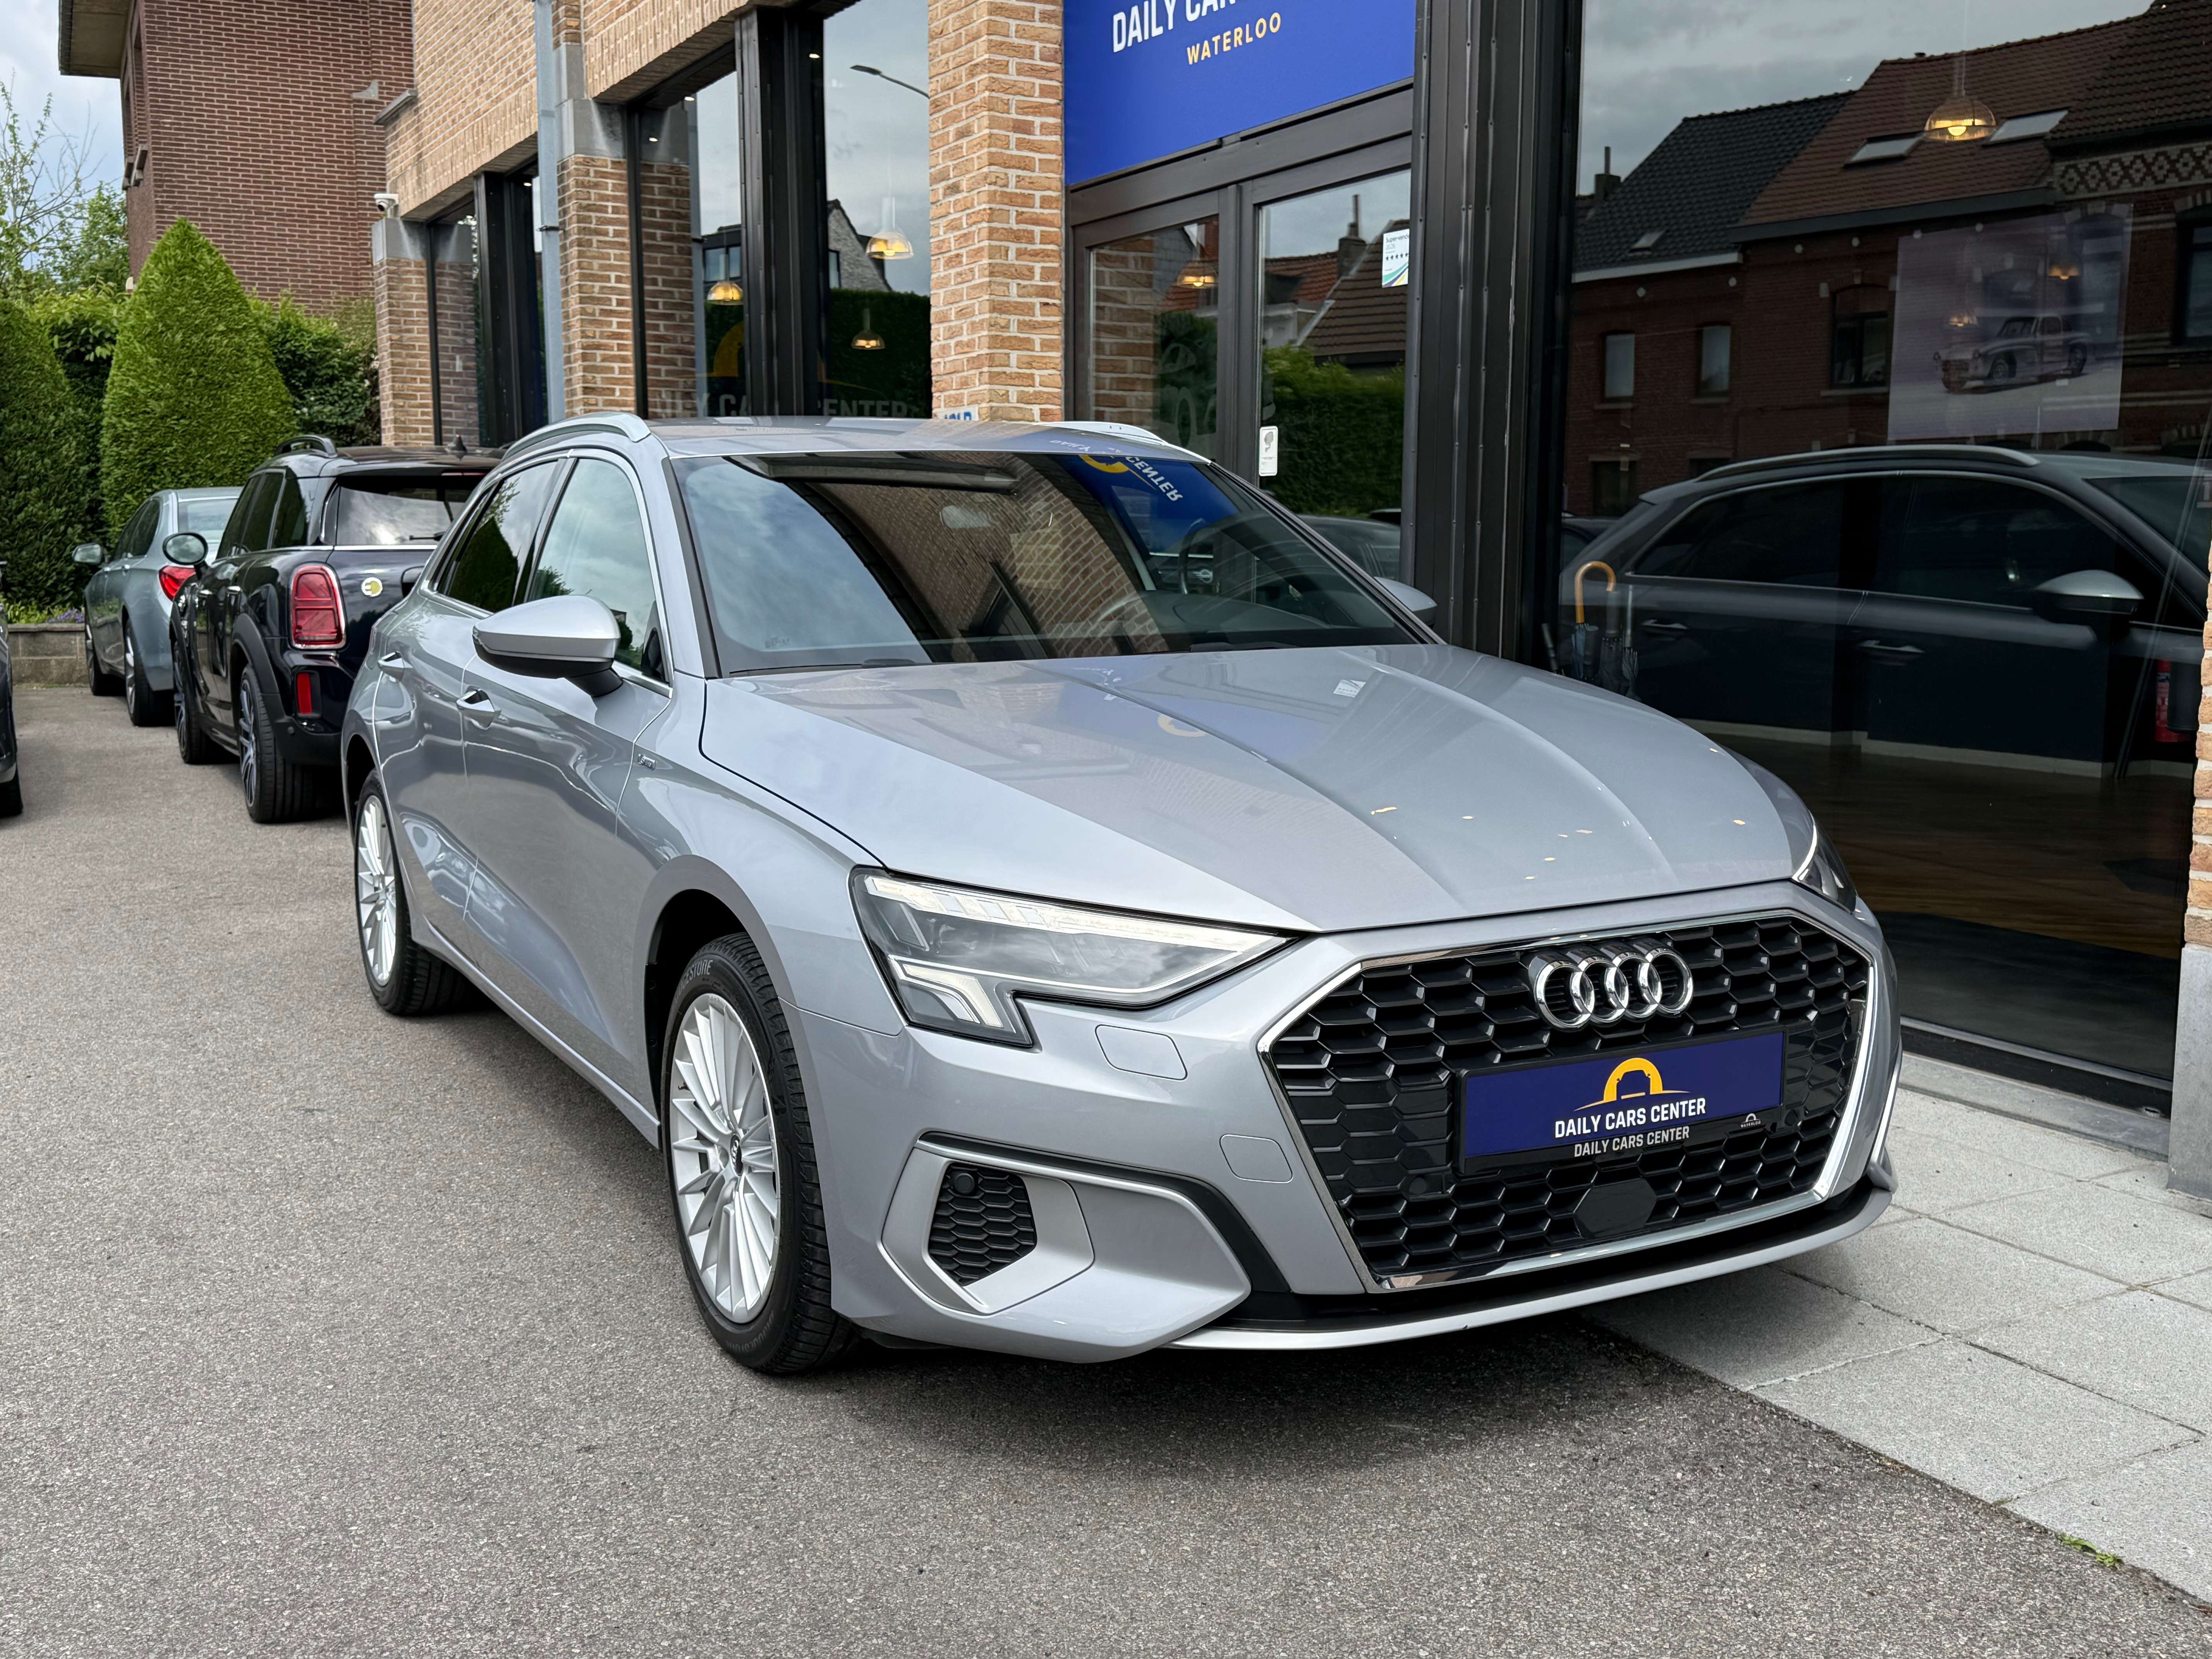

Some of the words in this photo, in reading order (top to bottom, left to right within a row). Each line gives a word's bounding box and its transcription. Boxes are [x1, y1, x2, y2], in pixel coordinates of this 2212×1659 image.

[1113, 0, 1176, 53] DAILY
[1187, 12, 1281, 65] WATERLOO
[817, 398, 907, 417] ENTER
[1555, 1114, 1601, 1139] DAILY
[1605, 1107, 1647, 1130] CARS
[1650, 1097, 1706, 1123] CENTER
[1574, 1139, 1609, 1158] DAILY
[1612, 1133, 1644, 1151] CARS
[1647, 1125, 1690, 1145] CENTER
